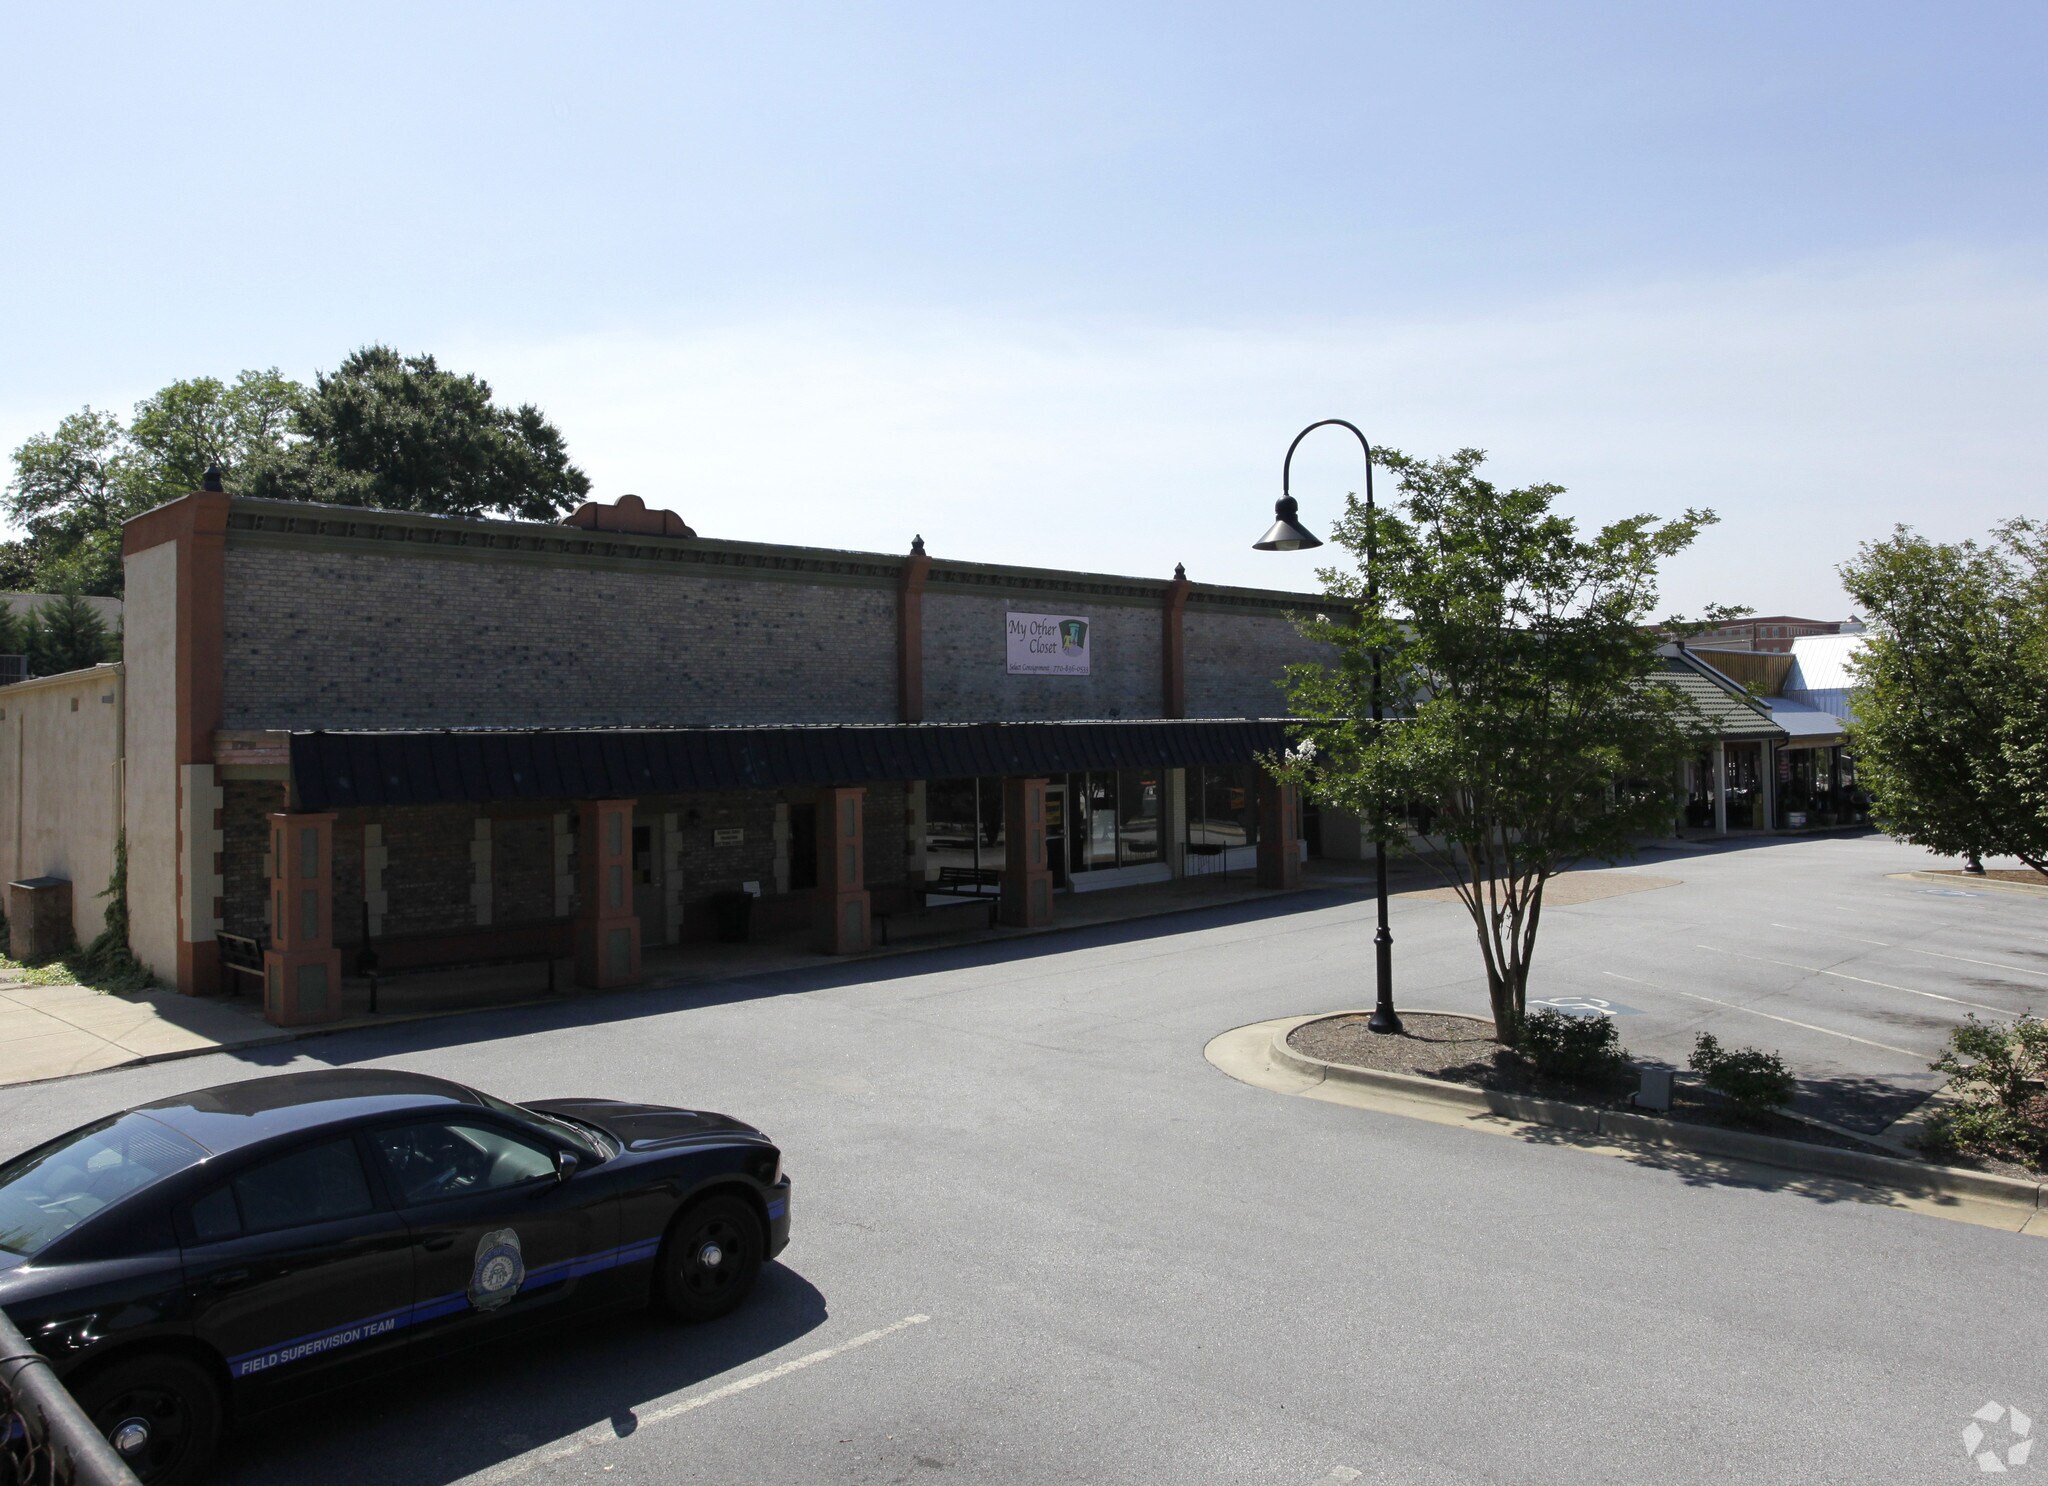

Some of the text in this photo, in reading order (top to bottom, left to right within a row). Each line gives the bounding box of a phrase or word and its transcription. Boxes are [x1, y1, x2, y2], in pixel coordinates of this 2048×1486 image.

[1008, 618, 1057, 641] My Other
[1029, 636, 1057, 653] Closet
[241, 1318, 395, 1375] FIELD SUPERVISION TEAM
